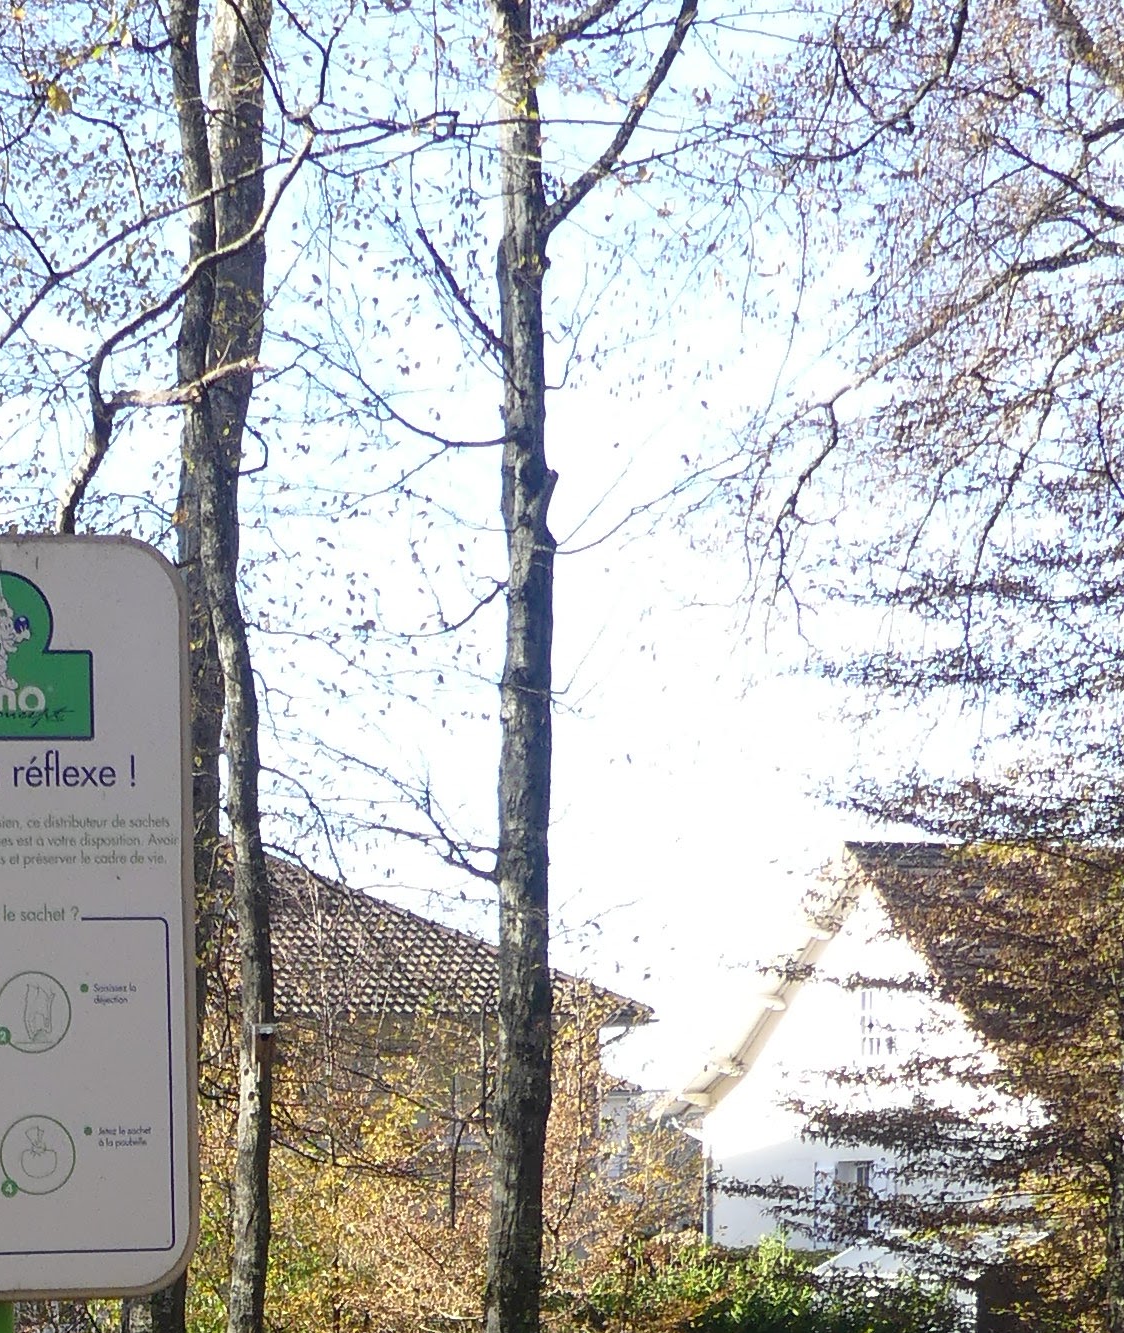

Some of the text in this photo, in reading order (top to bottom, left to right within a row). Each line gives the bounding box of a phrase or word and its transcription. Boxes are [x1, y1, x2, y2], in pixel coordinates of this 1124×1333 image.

[13, 750, 117, 788] réflexe
[130, 754, 137, 788] !
[27, 818, 41, 829] ce
[44, 814, 108, 829] distributeur
[111, 814, 126, 829] de
[128, 813, 171, 829] sachets
[16, 835, 33, 847] est
[36, 834, 45, 847] à
[47, 835, 76, 847] votre
[80, 832, 143, 850] disposition.
[147, 833, 180, 847] Avoir
[9, 852, 20, 865] et
[23, 853, 77, 868] préserver
[80, 850, 91, 865] le
[94, 850, 126, 864] cadre
[130, 850, 144, 864] de
[148, 852, 167, 865] vie.
[3, 904, 16, 922] le
[20, 903, 65, 922] sachet
[70, 905, 80, 920] ?
[129, 981, 137, 992] la
[118, 1125, 126, 1135] le
[107, 1137, 115, 1147] la
